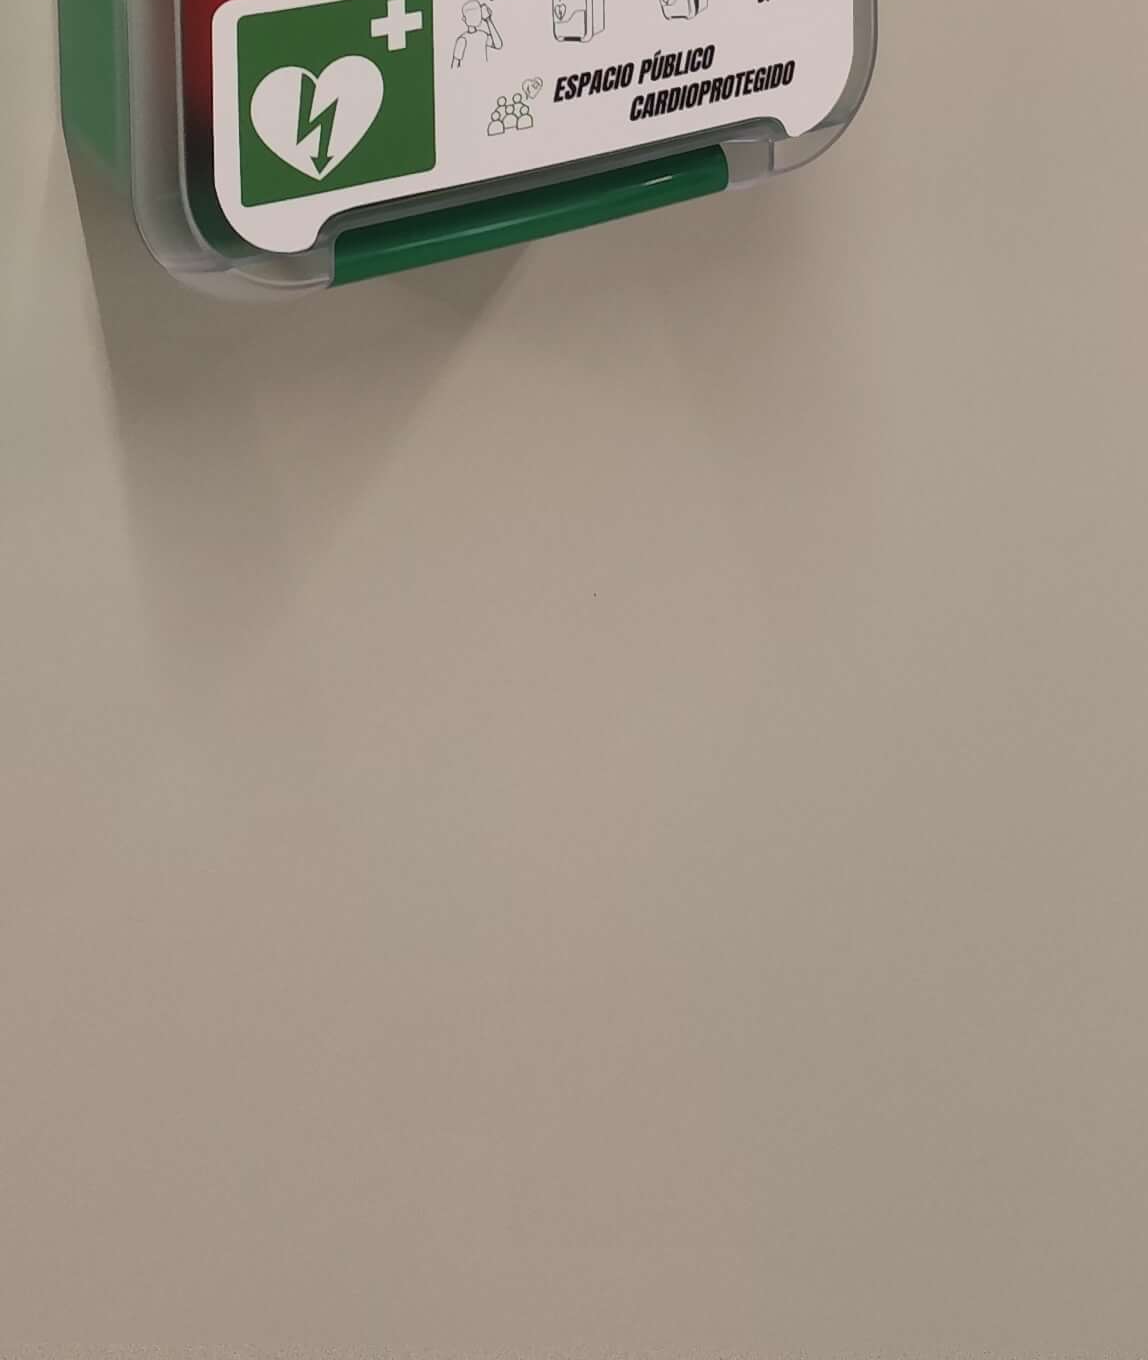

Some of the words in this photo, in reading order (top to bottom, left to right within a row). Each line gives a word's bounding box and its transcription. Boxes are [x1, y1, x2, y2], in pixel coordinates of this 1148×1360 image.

[553, 62, 635, 103] ESPACIO
[637, 44, 716, 84] PÚBLICO
[629, 60, 796, 121] CARDIOPROTEGIDO
